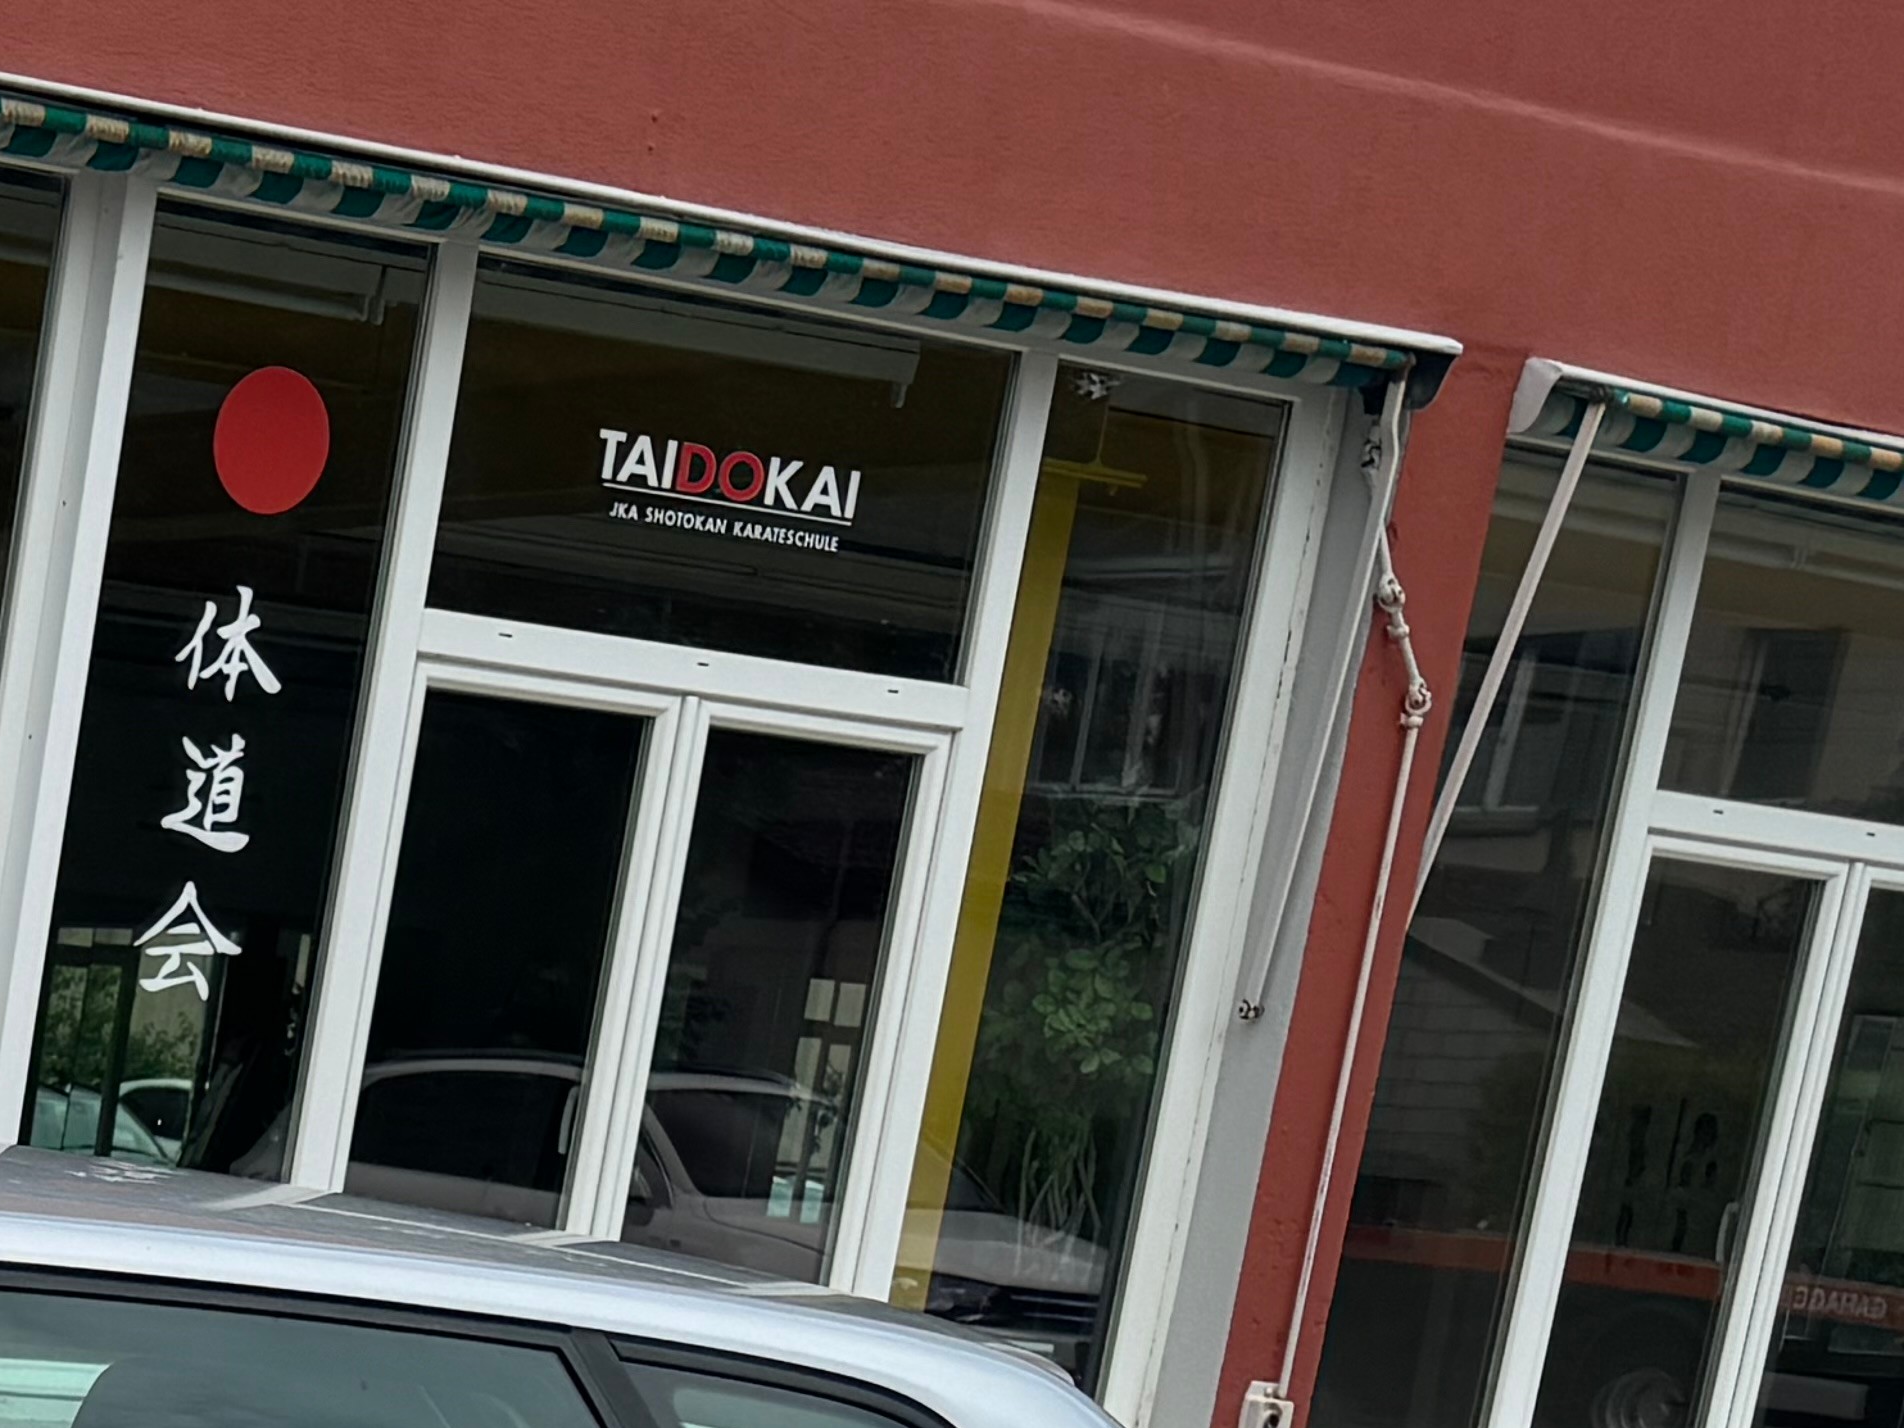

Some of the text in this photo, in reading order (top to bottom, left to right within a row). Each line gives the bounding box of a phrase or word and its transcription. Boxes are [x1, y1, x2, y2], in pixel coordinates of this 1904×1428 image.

[599, 428, 861, 519] TAIDOKAI
[609, 502, 840, 552] JKA SHOTOKAN KARATESCHULE
[134, 585, 282, 1001] 体道会
